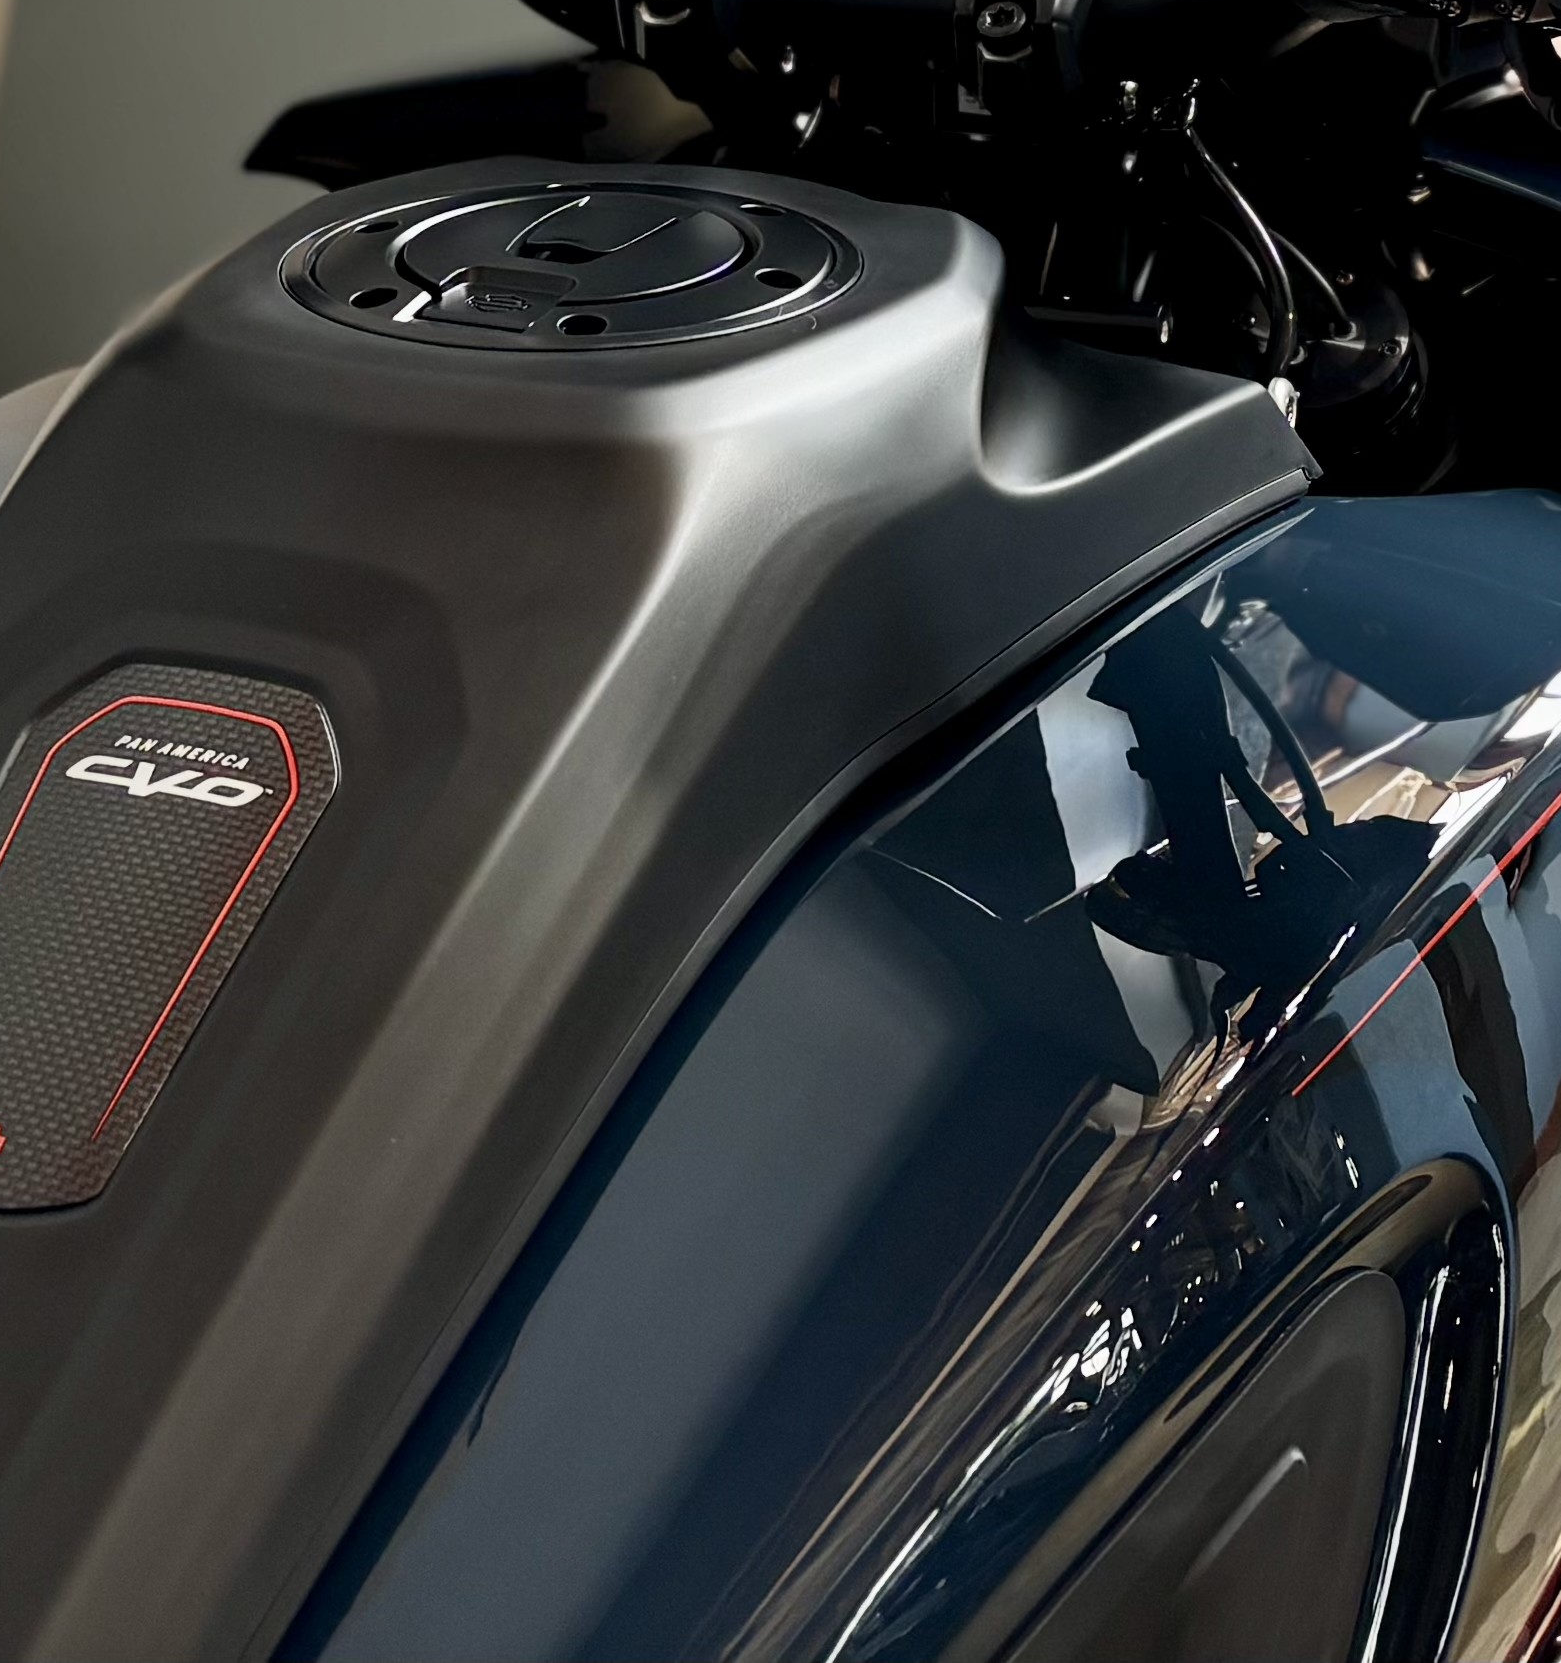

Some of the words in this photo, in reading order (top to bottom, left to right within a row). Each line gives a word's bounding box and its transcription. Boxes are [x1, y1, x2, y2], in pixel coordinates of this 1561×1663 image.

[114, 735, 158, 753] PAN
[156, 742, 250, 770] AMERICA
[65, 754, 265, 807] CVO
